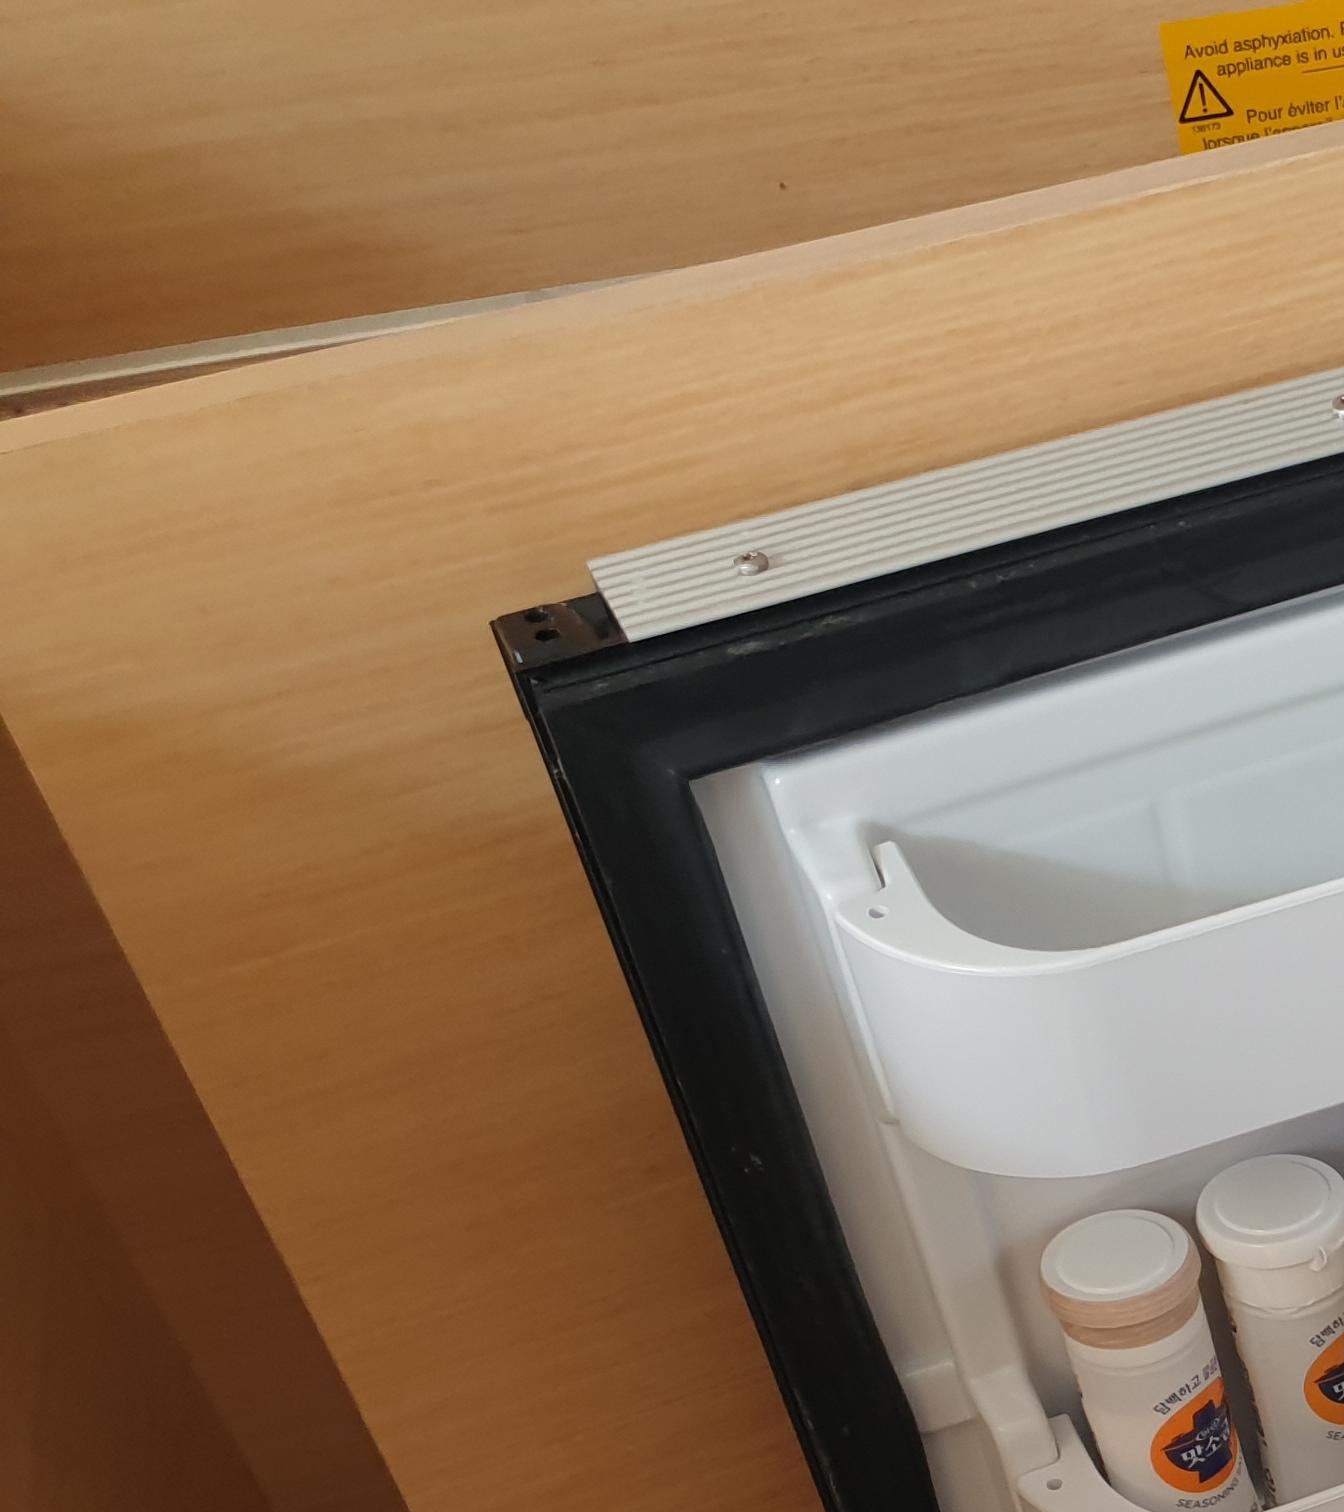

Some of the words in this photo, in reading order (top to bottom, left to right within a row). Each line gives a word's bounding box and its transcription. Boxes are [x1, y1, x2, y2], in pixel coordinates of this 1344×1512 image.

[1184, 39, 1228, 59] Avoid
[1233, 24, 1334, 53] asphyxiation.
[1216, 54, 1291, 78] appliance
[1297, 49, 1309, 64] is
[1314, 46, 1328, 61] in
[1246, 107, 1283, 124] Pour
[1287, 97, 1330, 116] éviter
